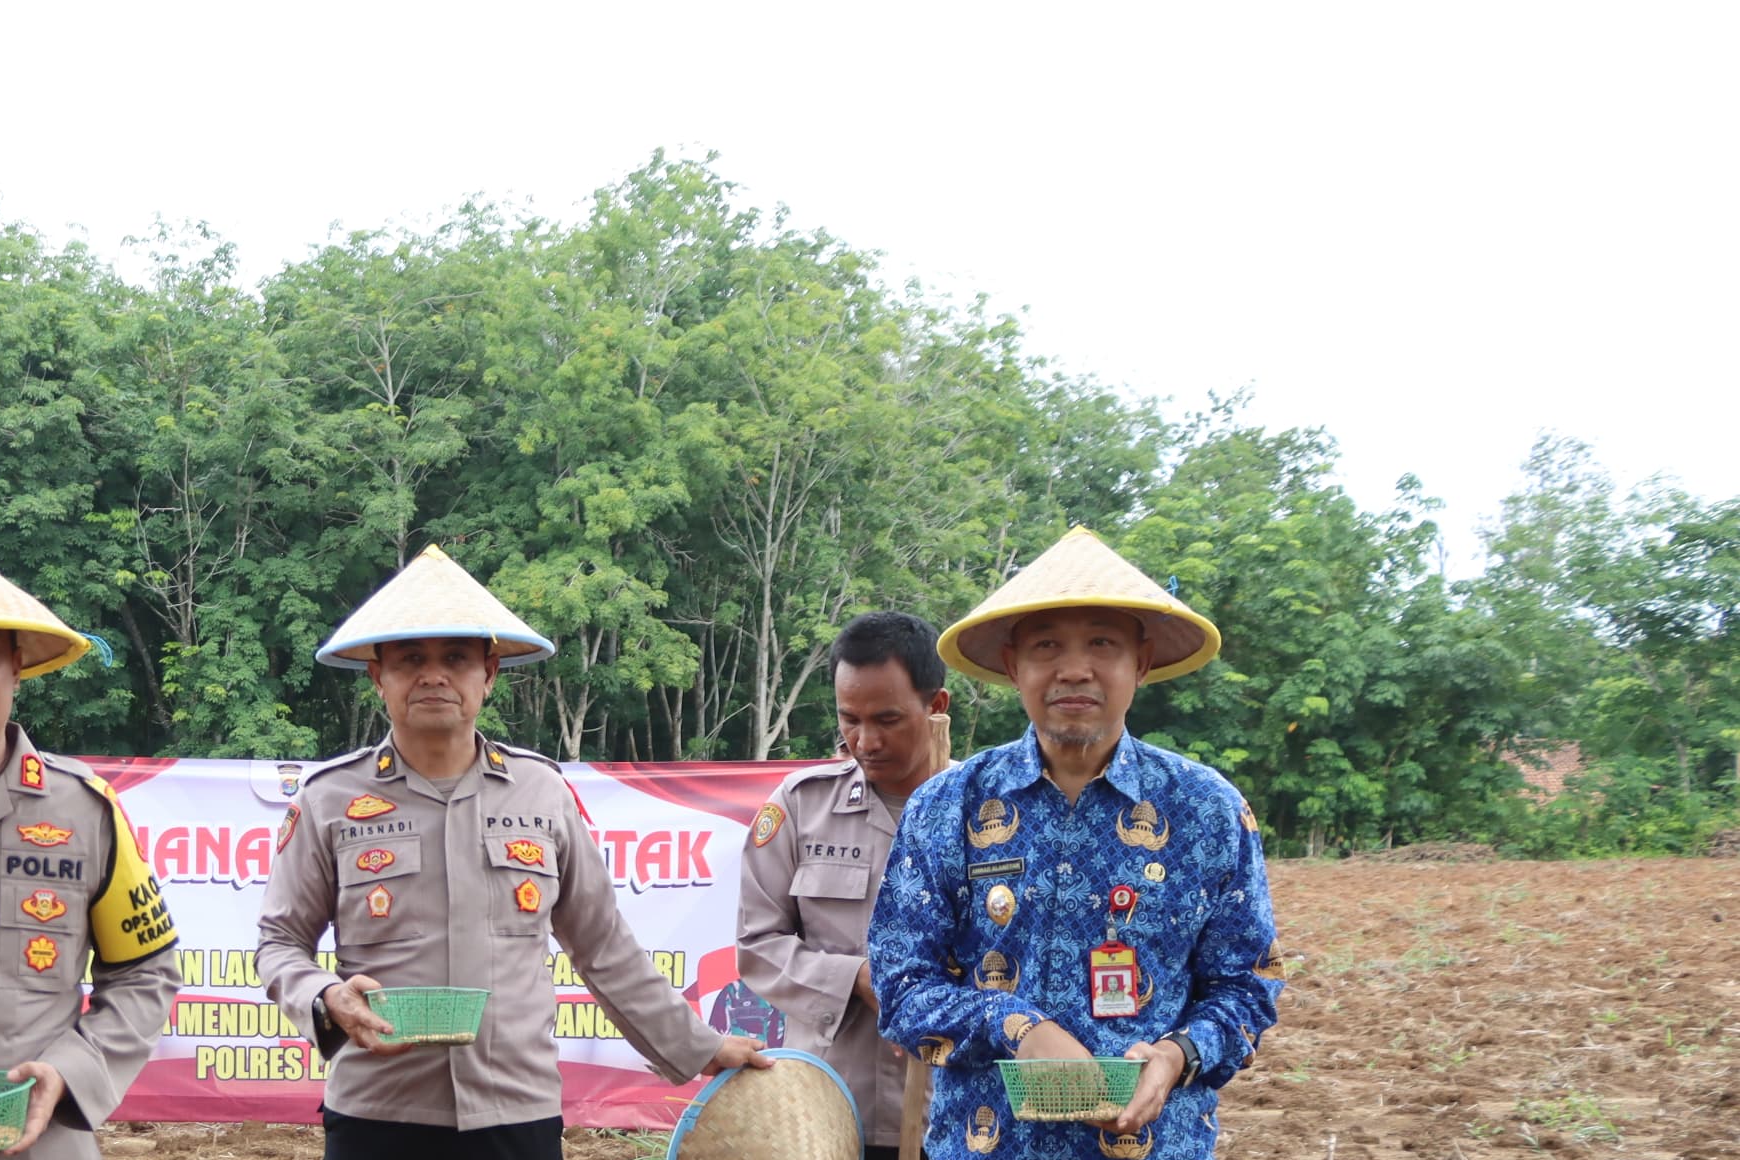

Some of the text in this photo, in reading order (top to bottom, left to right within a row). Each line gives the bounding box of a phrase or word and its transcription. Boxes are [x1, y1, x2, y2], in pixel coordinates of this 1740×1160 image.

[340, 820, 413, 841] TRISNADI
[486, 816, 553, 833] POLRI
[805, 844, 861, 859] TERTO
[6, 856, 83, 881] POLRI
[121, 911, 150, 934] OPS
[196, 1046, 303, 1081] POLRES
